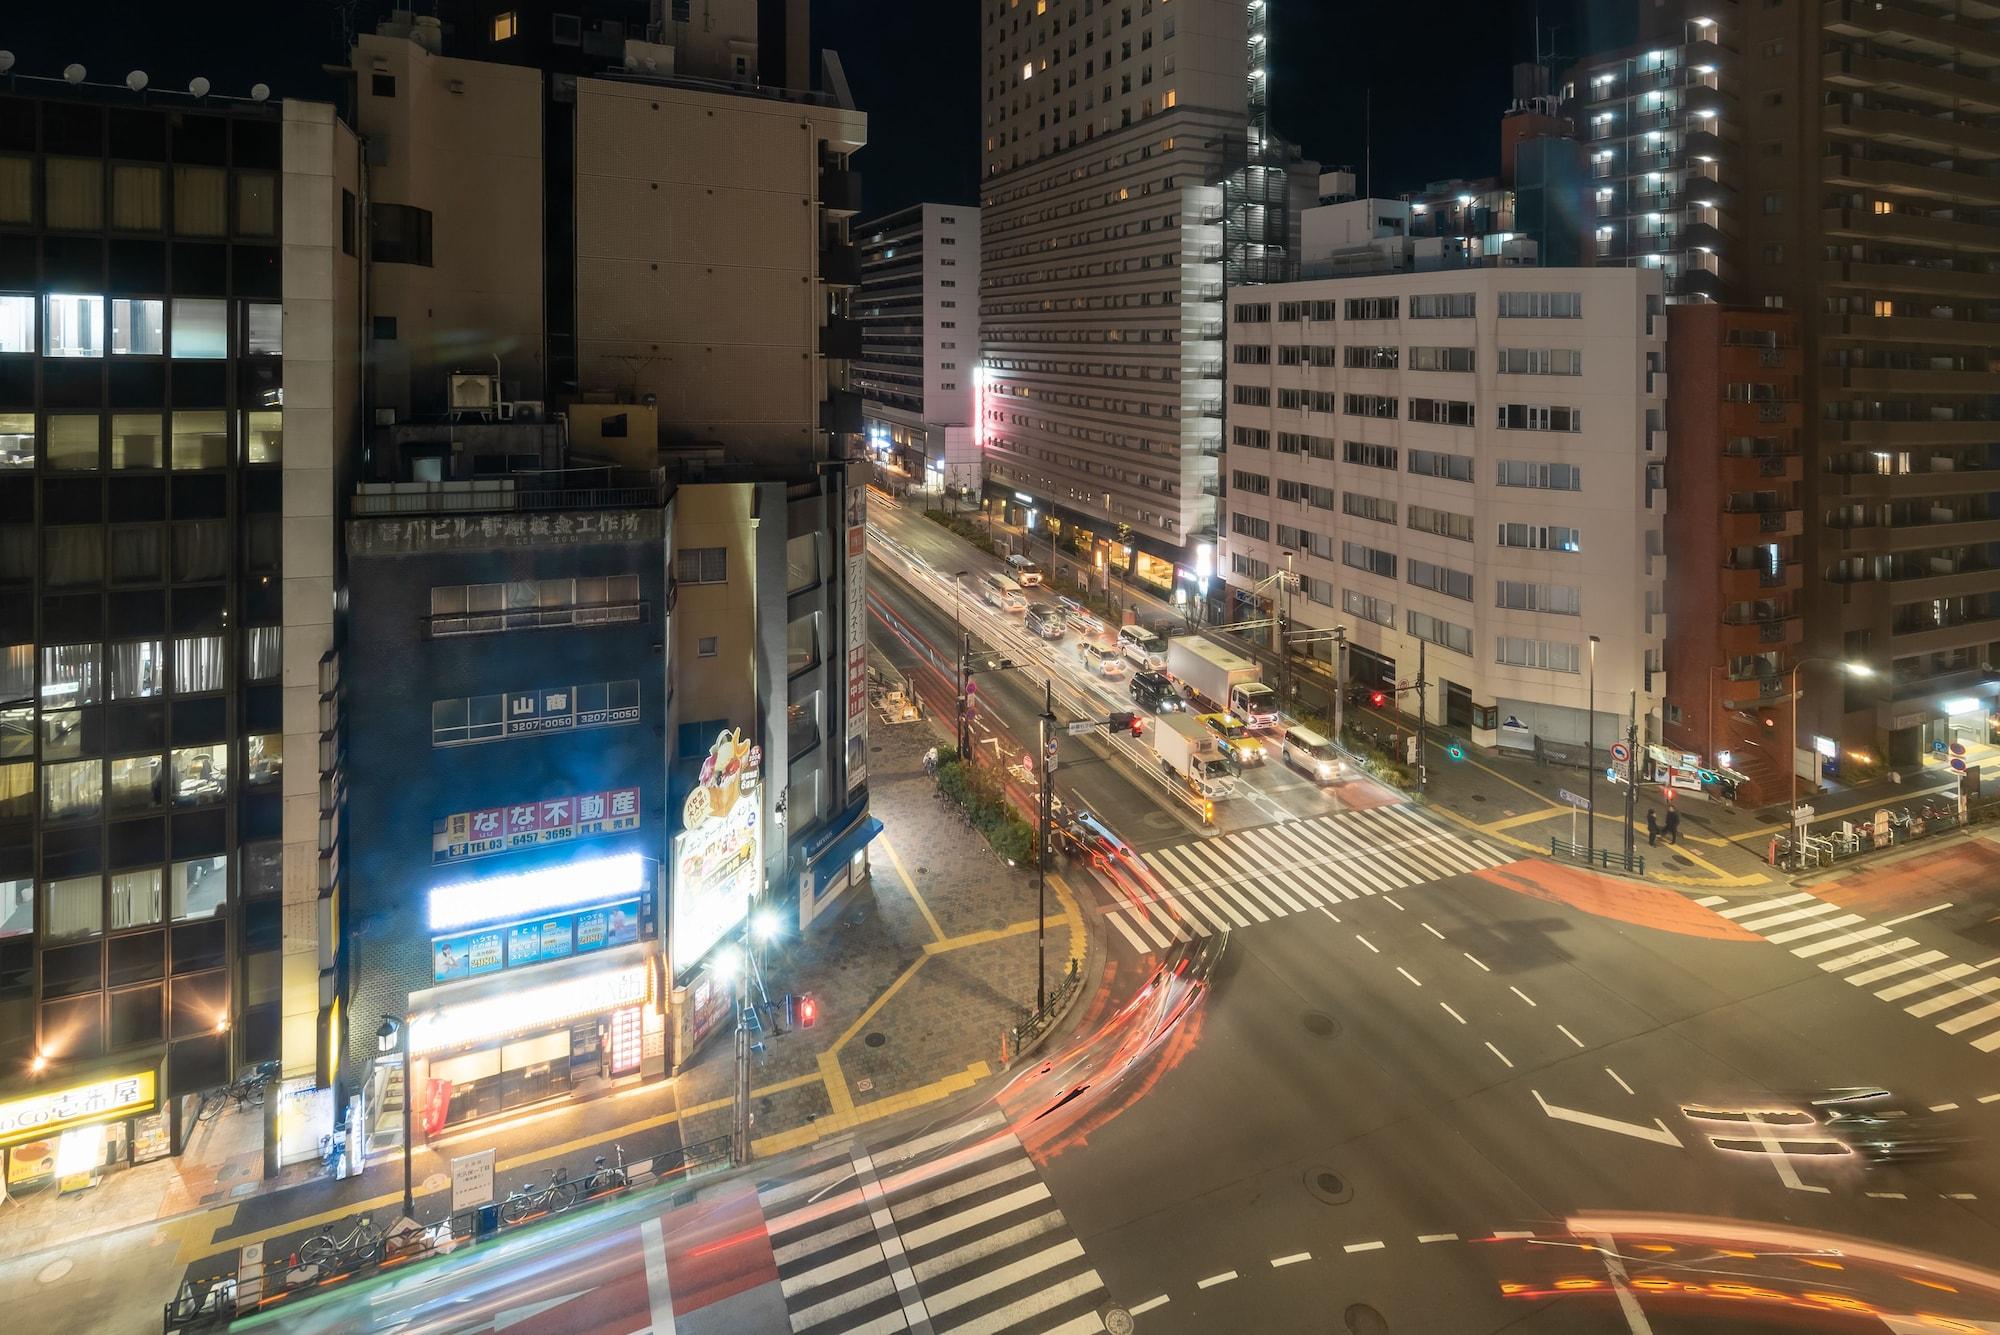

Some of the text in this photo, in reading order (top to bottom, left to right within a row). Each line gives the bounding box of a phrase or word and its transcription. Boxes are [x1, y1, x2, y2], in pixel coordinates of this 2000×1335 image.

[849, 561, 858, 643] ティップネス
[512, 709, 638, 732] 3207-0050 3207-0050
[474, 791, 636, 832] なな不動産
[453, 844, 467, 855] 3F
